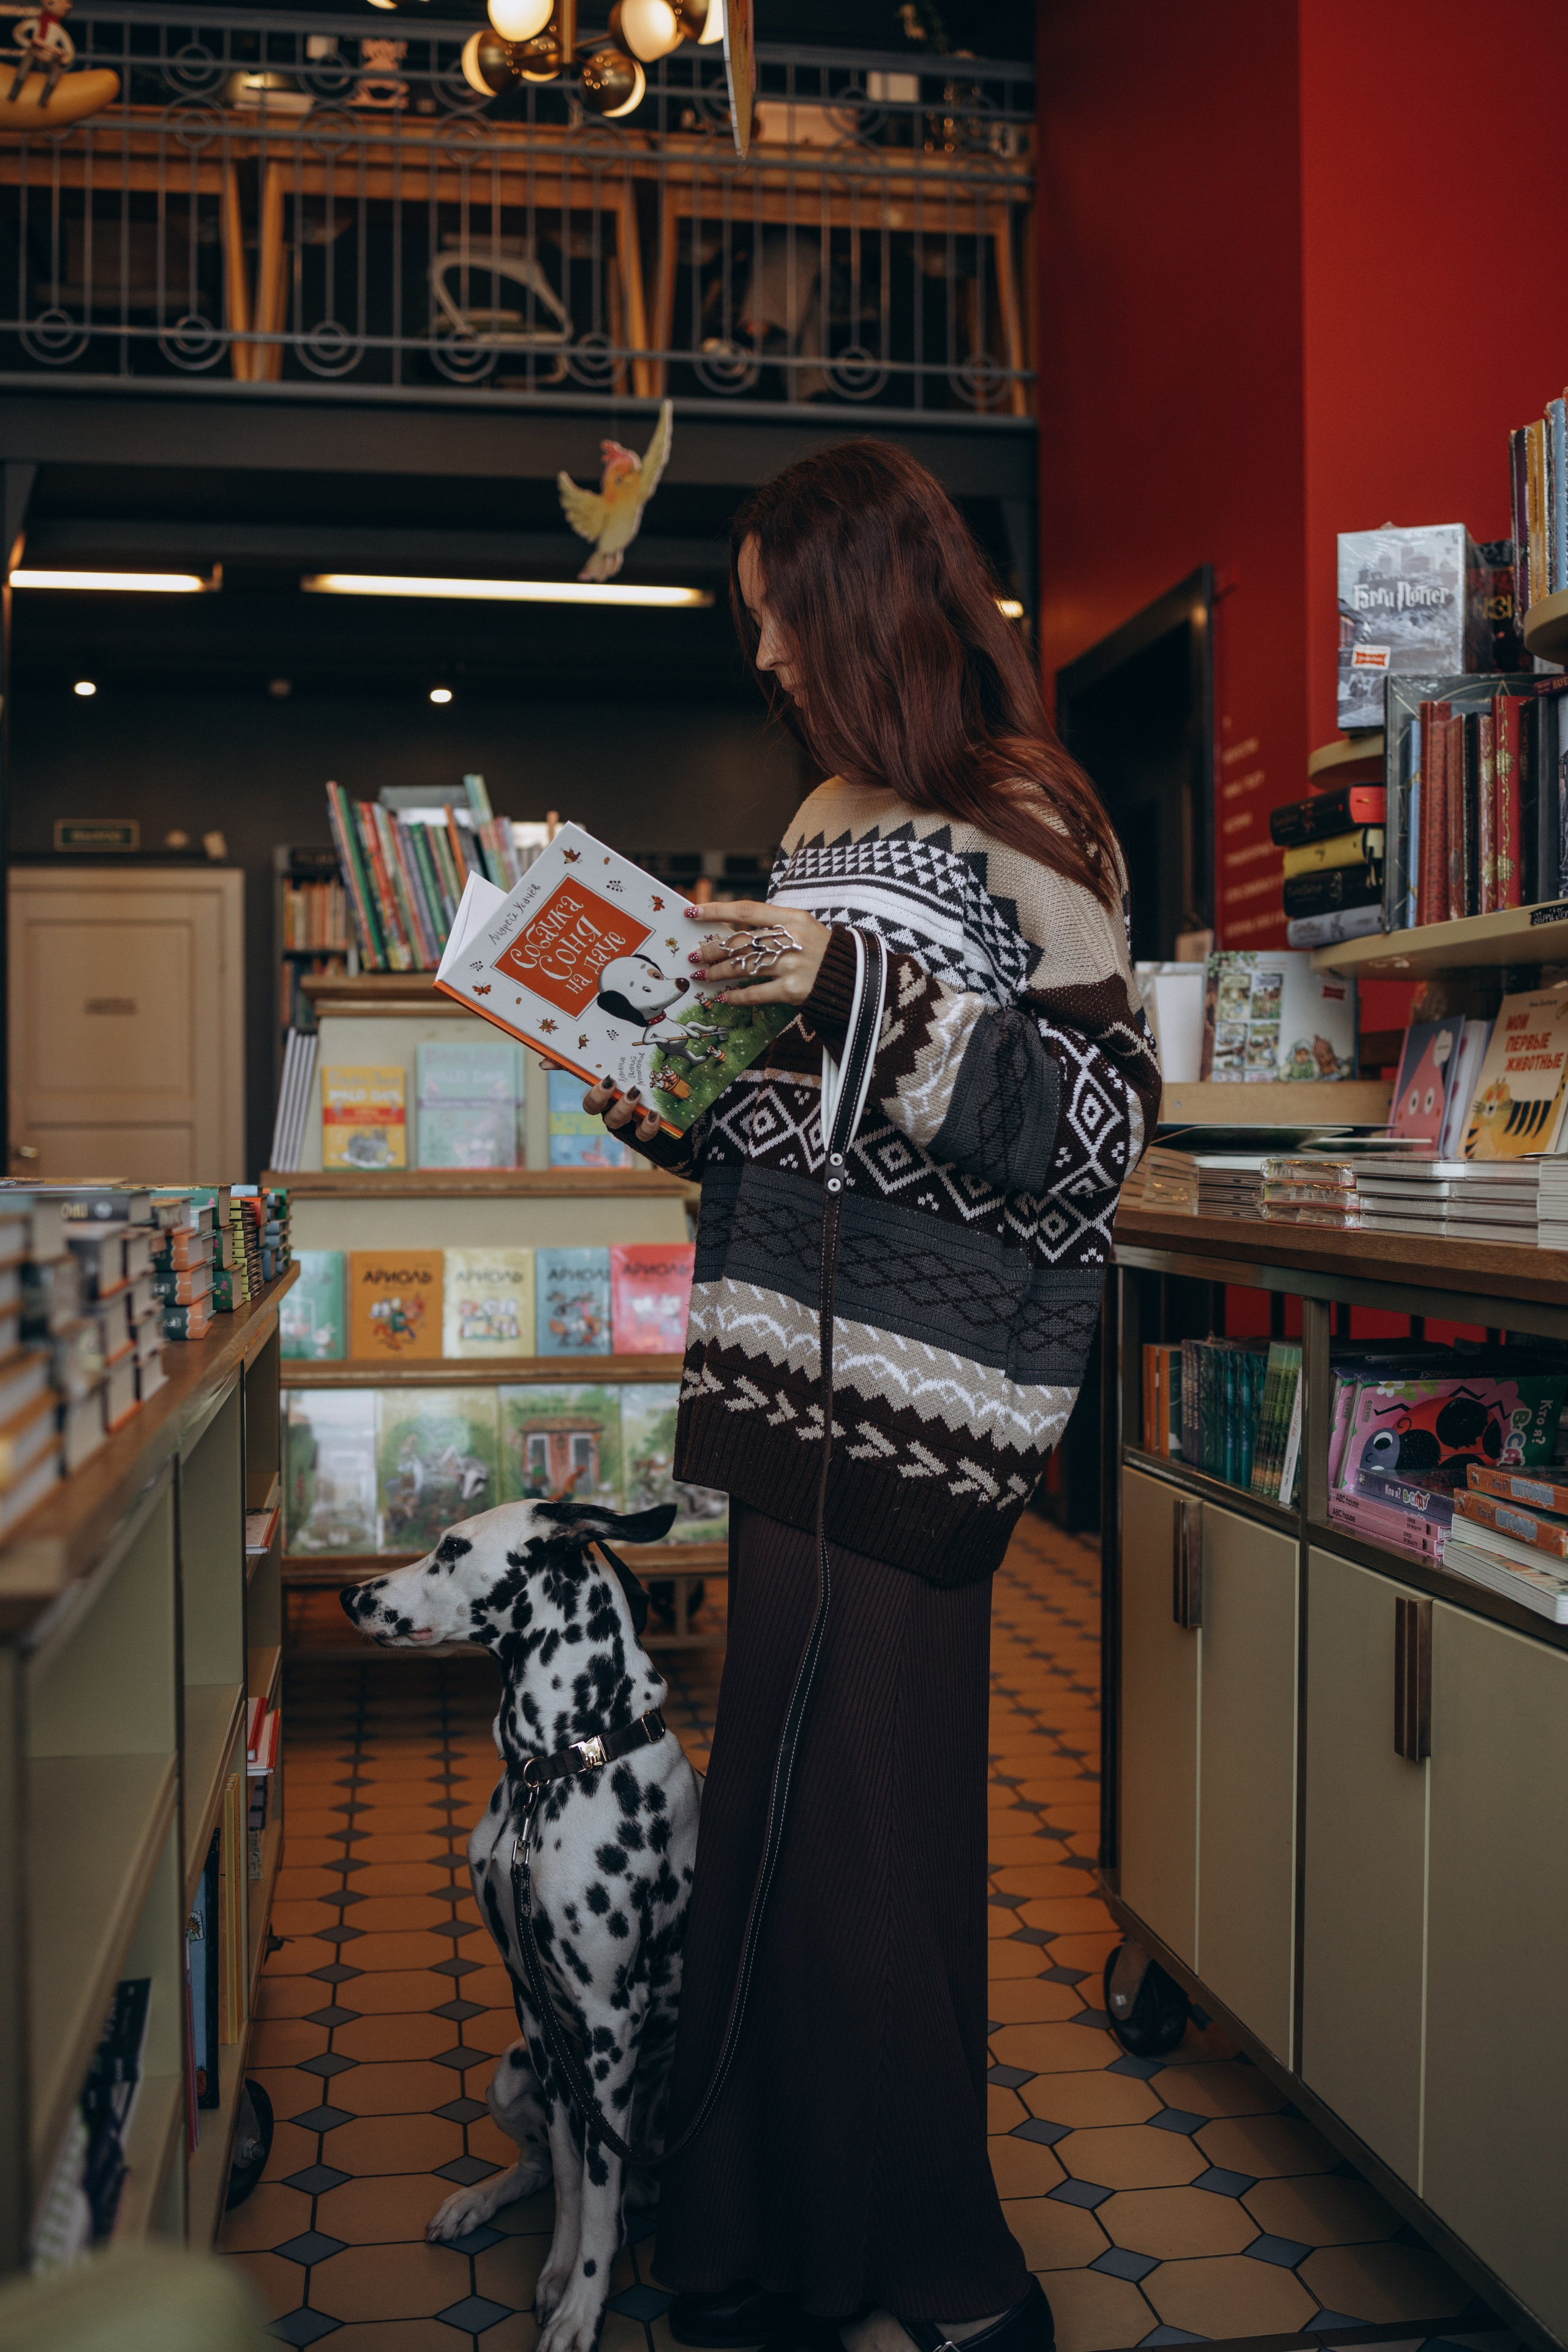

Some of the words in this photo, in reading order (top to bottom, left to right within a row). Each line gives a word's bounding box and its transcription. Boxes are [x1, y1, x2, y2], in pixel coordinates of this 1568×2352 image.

[1353, 582, 1395, 611] Гарри
[488, 912, 518, 945] Андрей
[513, 883, 541, 914] Усачёв
[510, 895, 584, 968] Собачка
[539, 914, 603, 980] Соня
[565, 973, 593, 994] на
[583, 932, 626, 975] даче
[1506, 1013, 1530, 1031] МОИ
[1505, 1031, 1552, 1053] ПЕРВЫЕ
[617, 1055, 628, 1082] Художник
[628, 1055, 637, 1078] Евгений
[635, 1052, 646, 1086] Антоненков
[1505, 1053, 1564, 1072] ЖИВОТНЫЕ
[363, 1268, 432, 1285] АРИОЛЬ
[1364, 1400, 1373, 1423] CLEVER
[1536, 1399, 1554, 1425] Кто
[1531, 1429, 1546, 1444] я?
[1336, 1493, 1346, 1502] ABC
[1385, 1483, 1394, 1496] Кто
[1393, 1487, 1401, 1499] я?
[1332, 1507, 1341, 1518] ABC
[1342, 1510, 1355, 1523] house
